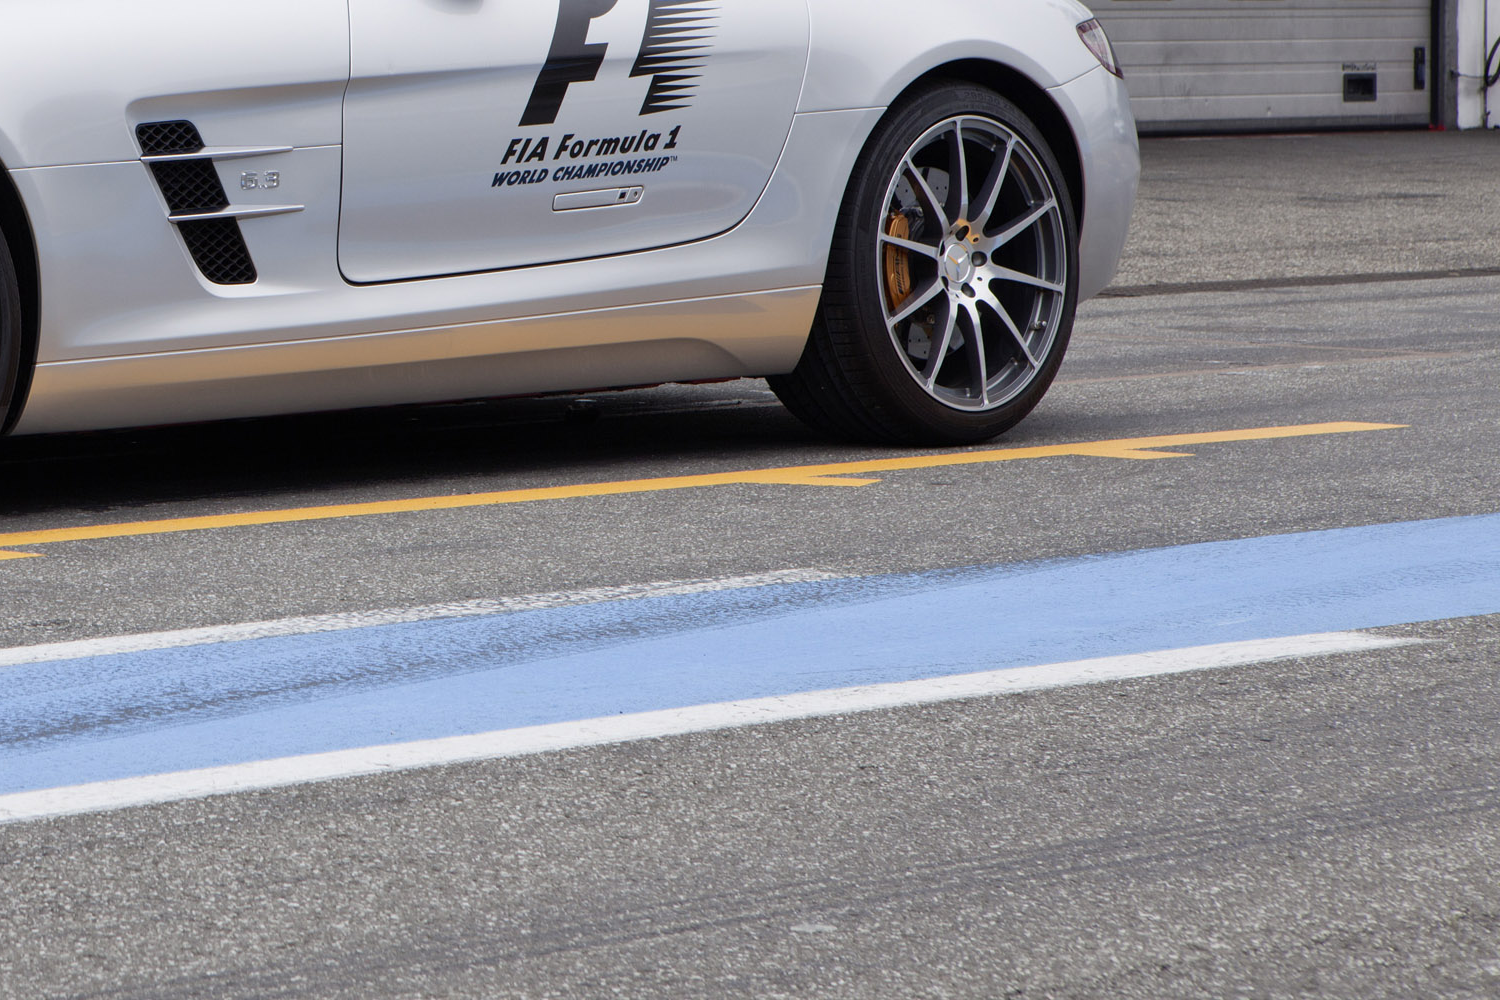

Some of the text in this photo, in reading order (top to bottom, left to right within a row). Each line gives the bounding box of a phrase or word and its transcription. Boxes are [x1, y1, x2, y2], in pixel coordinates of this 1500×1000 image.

[500, 124, 682, 165] FIA Formula 1
[240, 170, 280, 191] 6.3
[491, 167, 549, 188] WORLD
